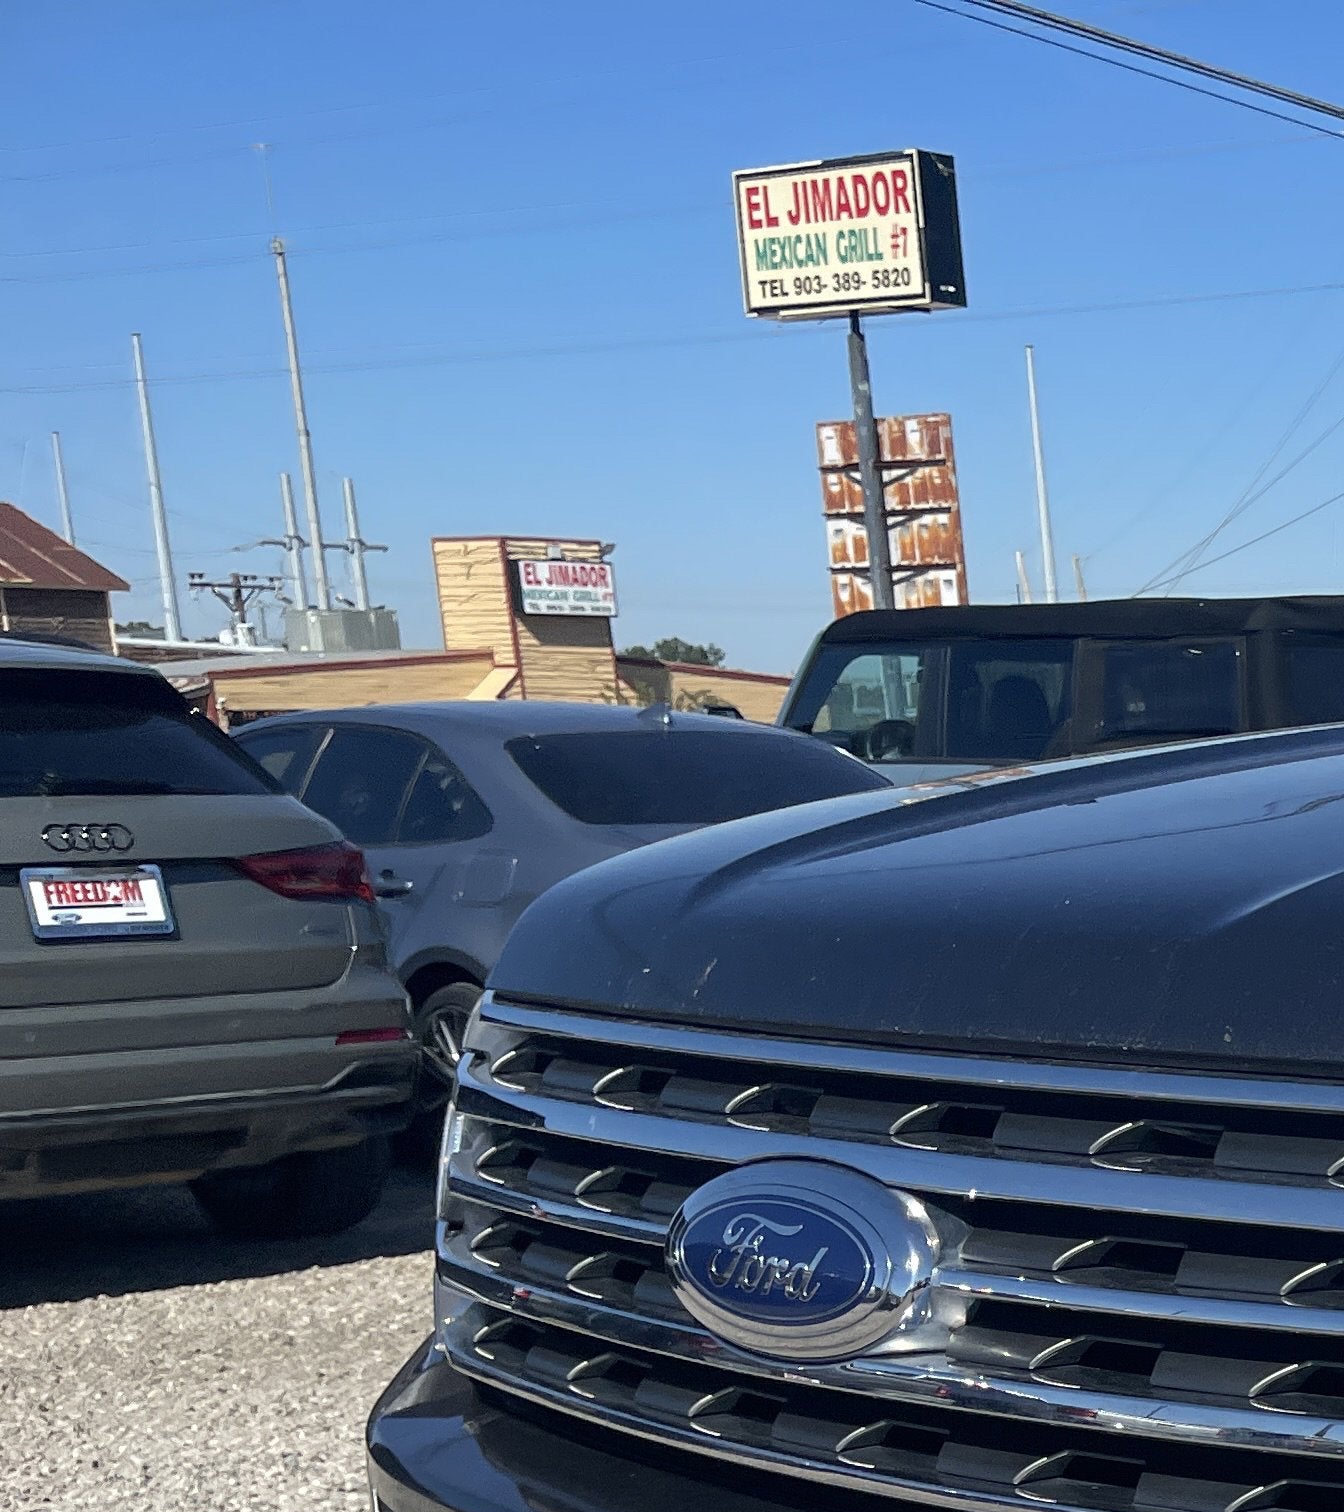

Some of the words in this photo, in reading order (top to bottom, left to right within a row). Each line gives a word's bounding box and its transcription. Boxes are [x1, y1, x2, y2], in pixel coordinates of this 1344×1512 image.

[745, 185, 780, 230] EL
[787, 169, 912, 226] JIMADOR
[753, 232, 829, 272] MEXICAN
[835, 227, 884, 264] GRILL
[758, 278, 789, 299] TEL
[793, 274, 828, 296] 903-
[832, 271, 866, 292] 389-
[871, 266, 911, 289] 5820
[524, 562, 542, 585] EL
[546, 564, 609, 588] JIMADOR
[706, 1212, 829, 1303] Ford
